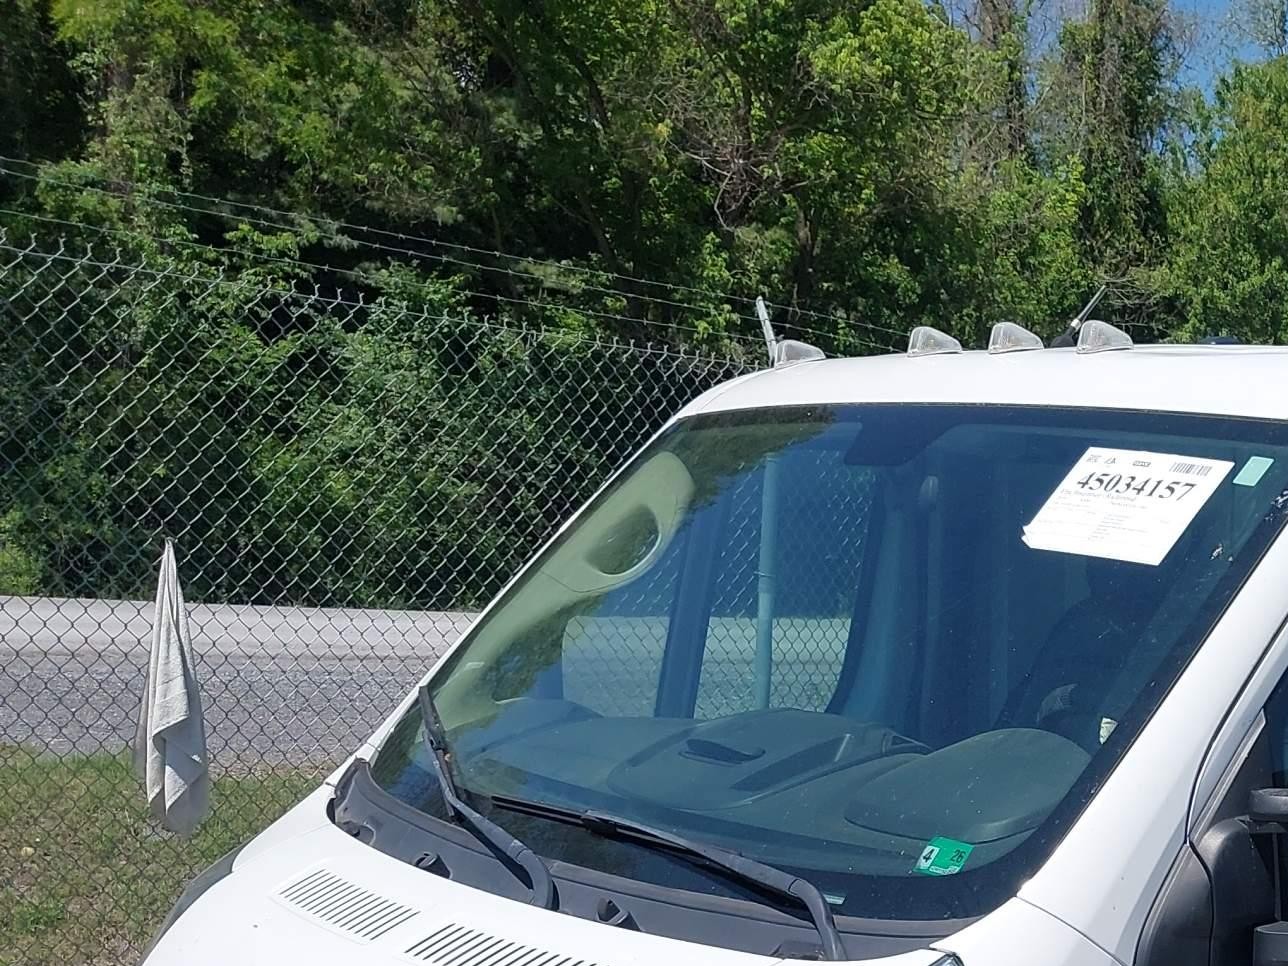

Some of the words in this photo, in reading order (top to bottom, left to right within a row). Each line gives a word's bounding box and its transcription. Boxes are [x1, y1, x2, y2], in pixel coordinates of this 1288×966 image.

[1076, 471, 1197, 501] 45034157
[922, 848, 935, 863] 4
[950, 849, 966, 864] 26
